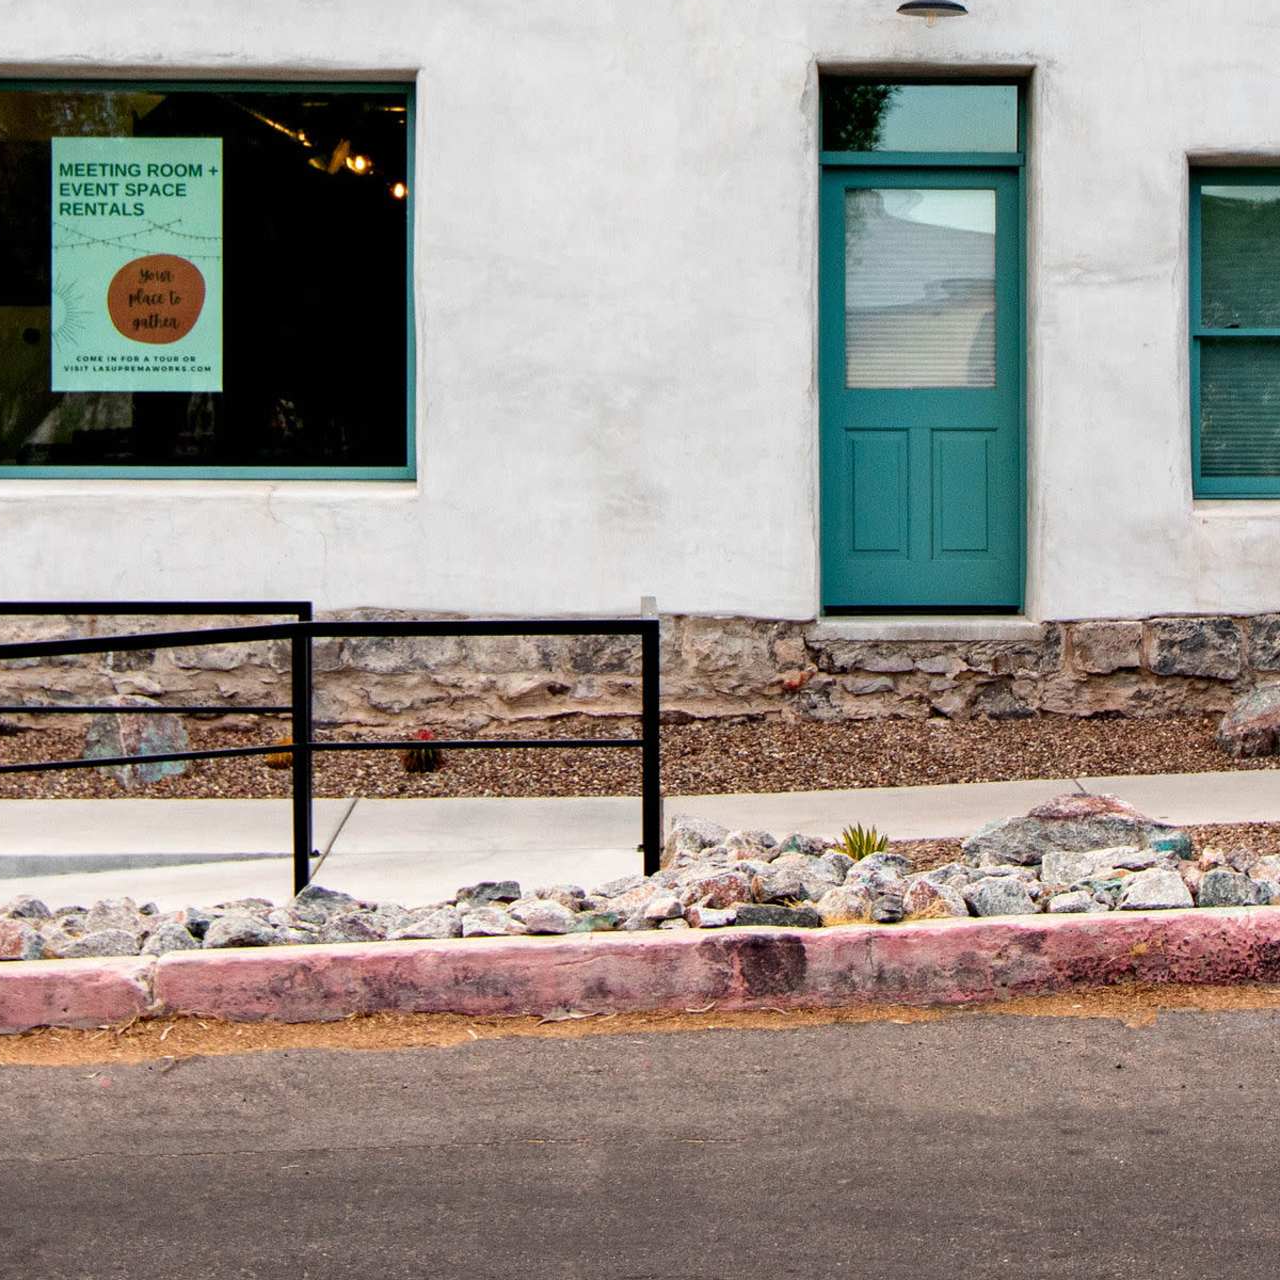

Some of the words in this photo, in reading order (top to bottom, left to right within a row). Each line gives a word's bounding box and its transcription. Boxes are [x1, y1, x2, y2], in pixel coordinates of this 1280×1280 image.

[59, 163, 141, 178] MEETING
[147, 163, 203, 178] ROOM
[208, 166, 219, 177] +
[59, 183, 120, 197] EVENT
[125, 183, 187, 197] SPACE
[59, 202, 145, 217] RENTALS
[128, 288, 164, 308] place
[168, 290, 182, 306] to
[76, 355, 103, 363] COME
[107, 355, 118, 363] IN
[121, 355, 140, 363] FOR
[143, 355, 150, 363] A
[154, 355, 179, 363] TOUR
[63, 365, 89, 373] VISIT
